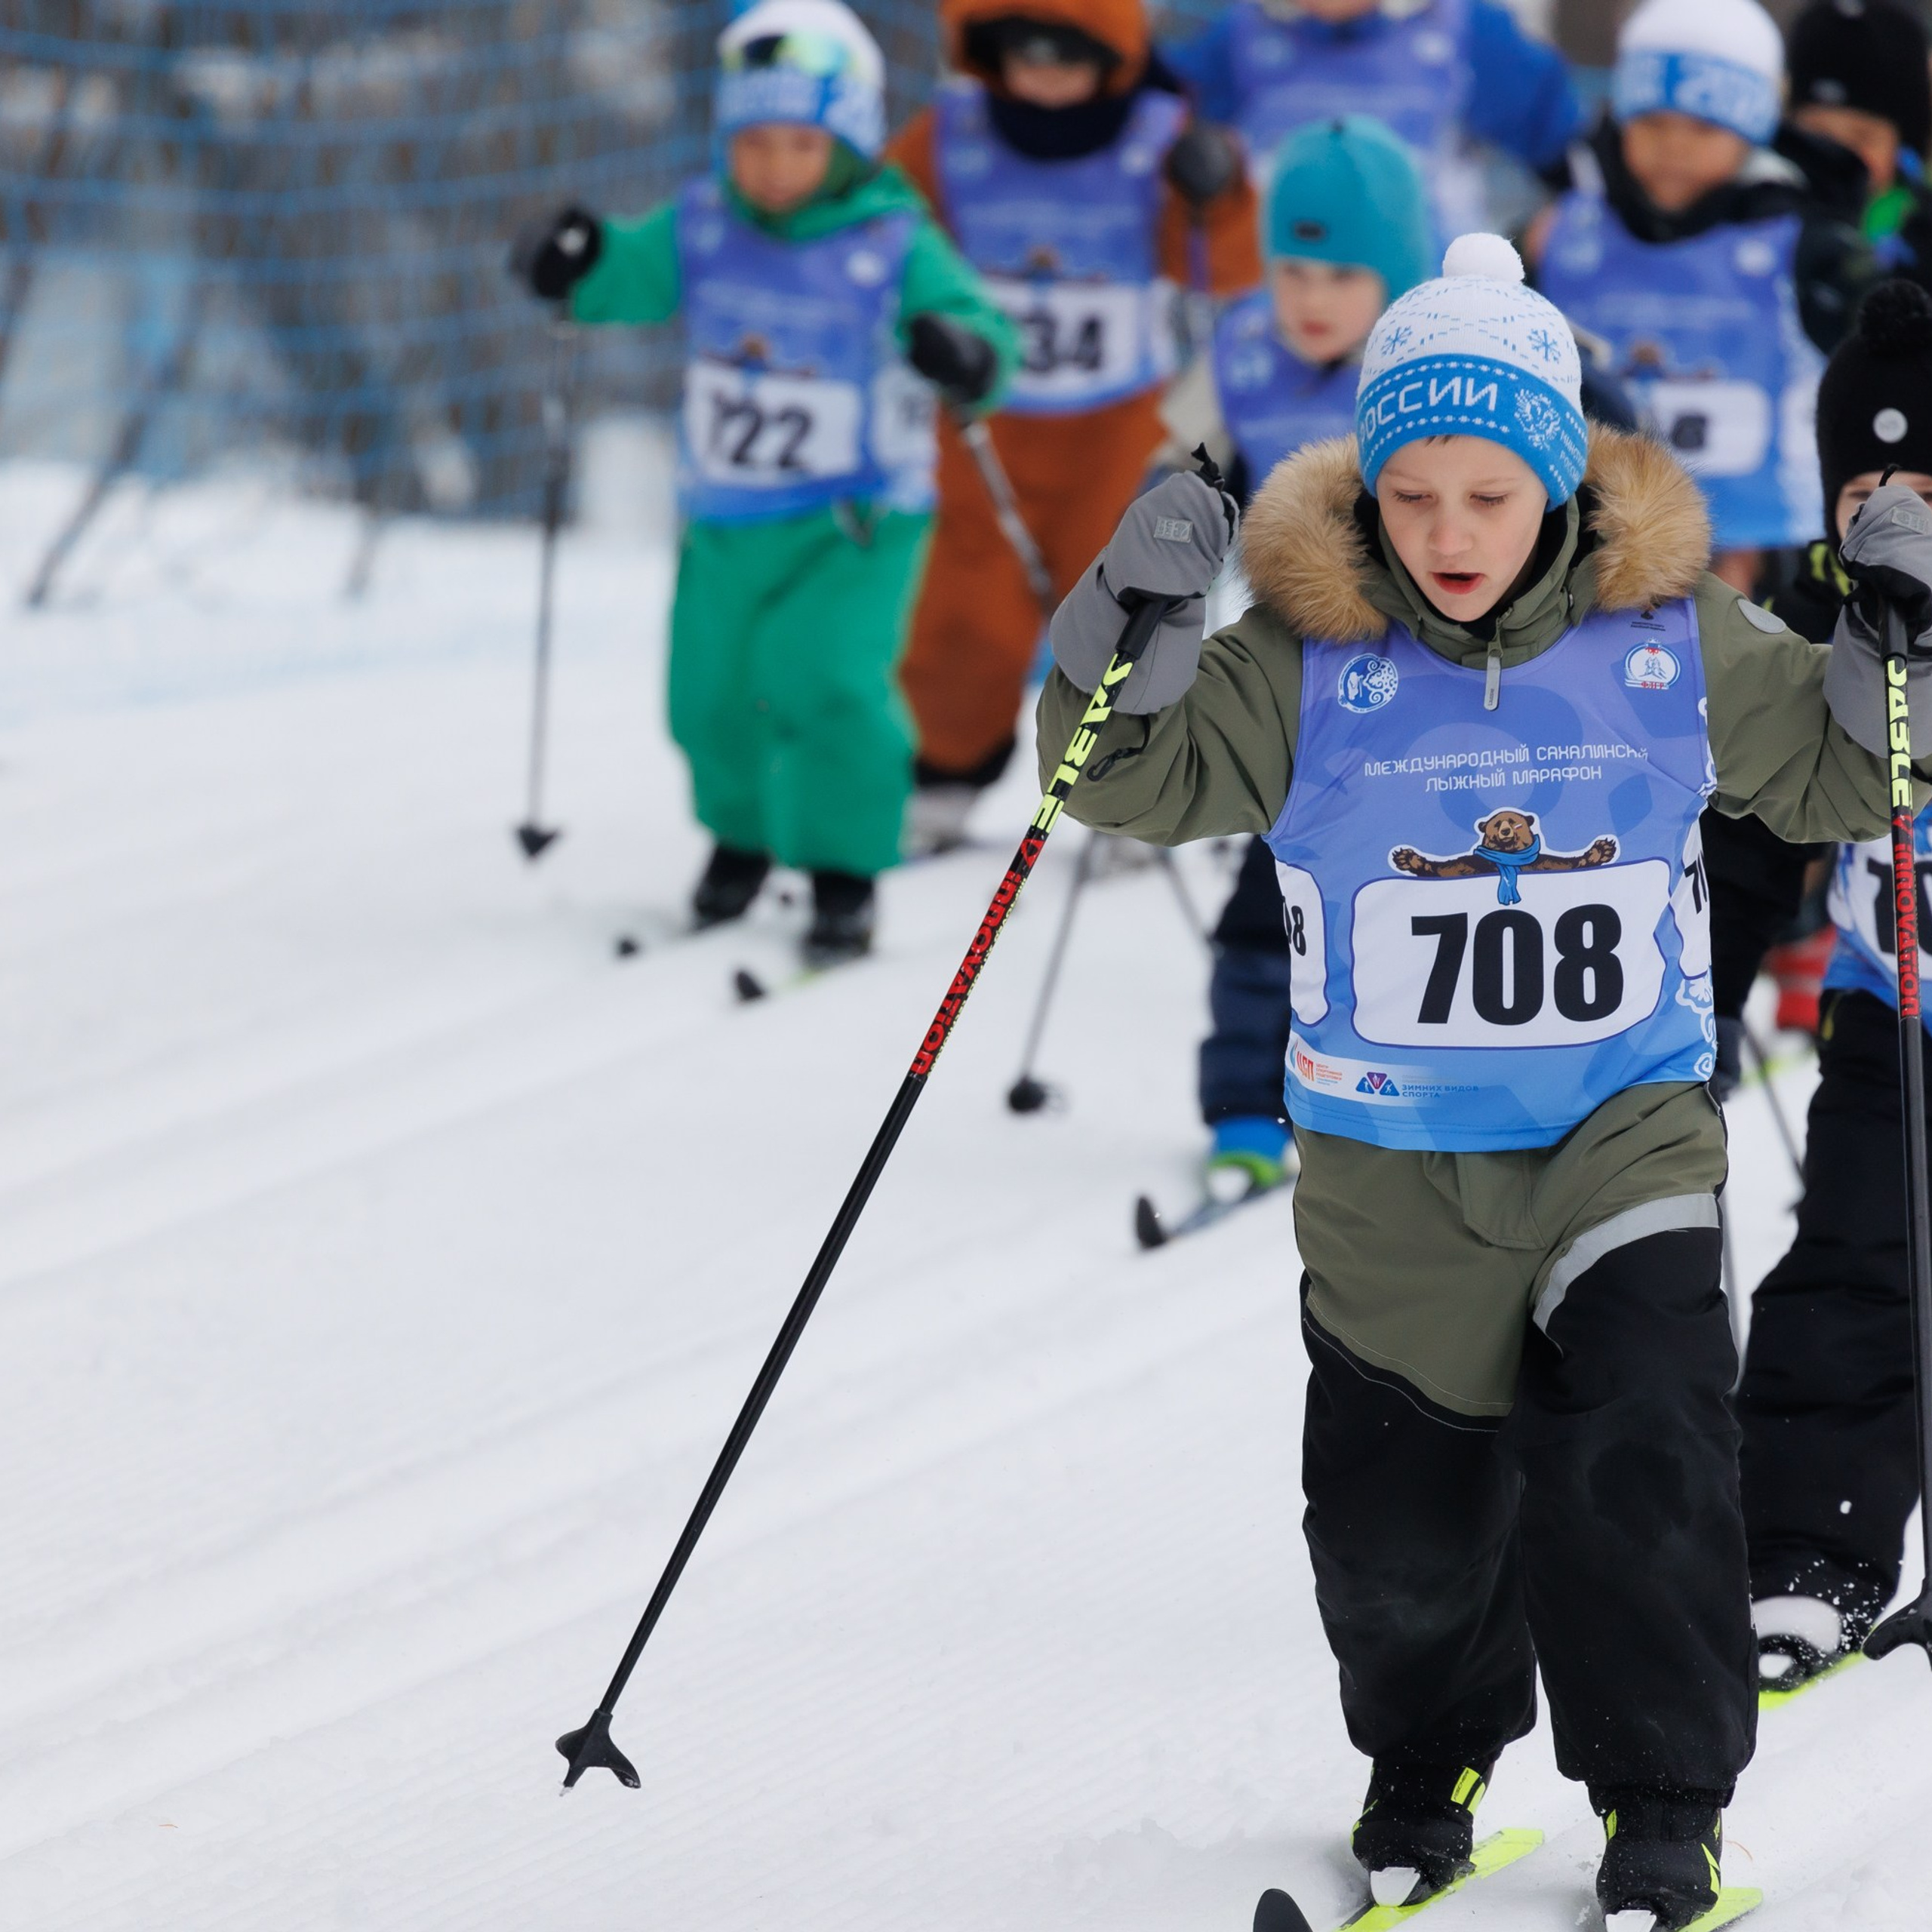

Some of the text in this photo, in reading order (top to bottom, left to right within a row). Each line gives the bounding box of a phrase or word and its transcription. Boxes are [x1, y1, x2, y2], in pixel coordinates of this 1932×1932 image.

[1027, 653, 1133, 834] SABLE
[1364, 743, 1530, 777] МЕЖДУНАРОДНЫЙ
[1425, 765, 1602, 792] ЛЫЖНЫЙ МАРАФОН
[1411, 903, 1624, 1026] 708
